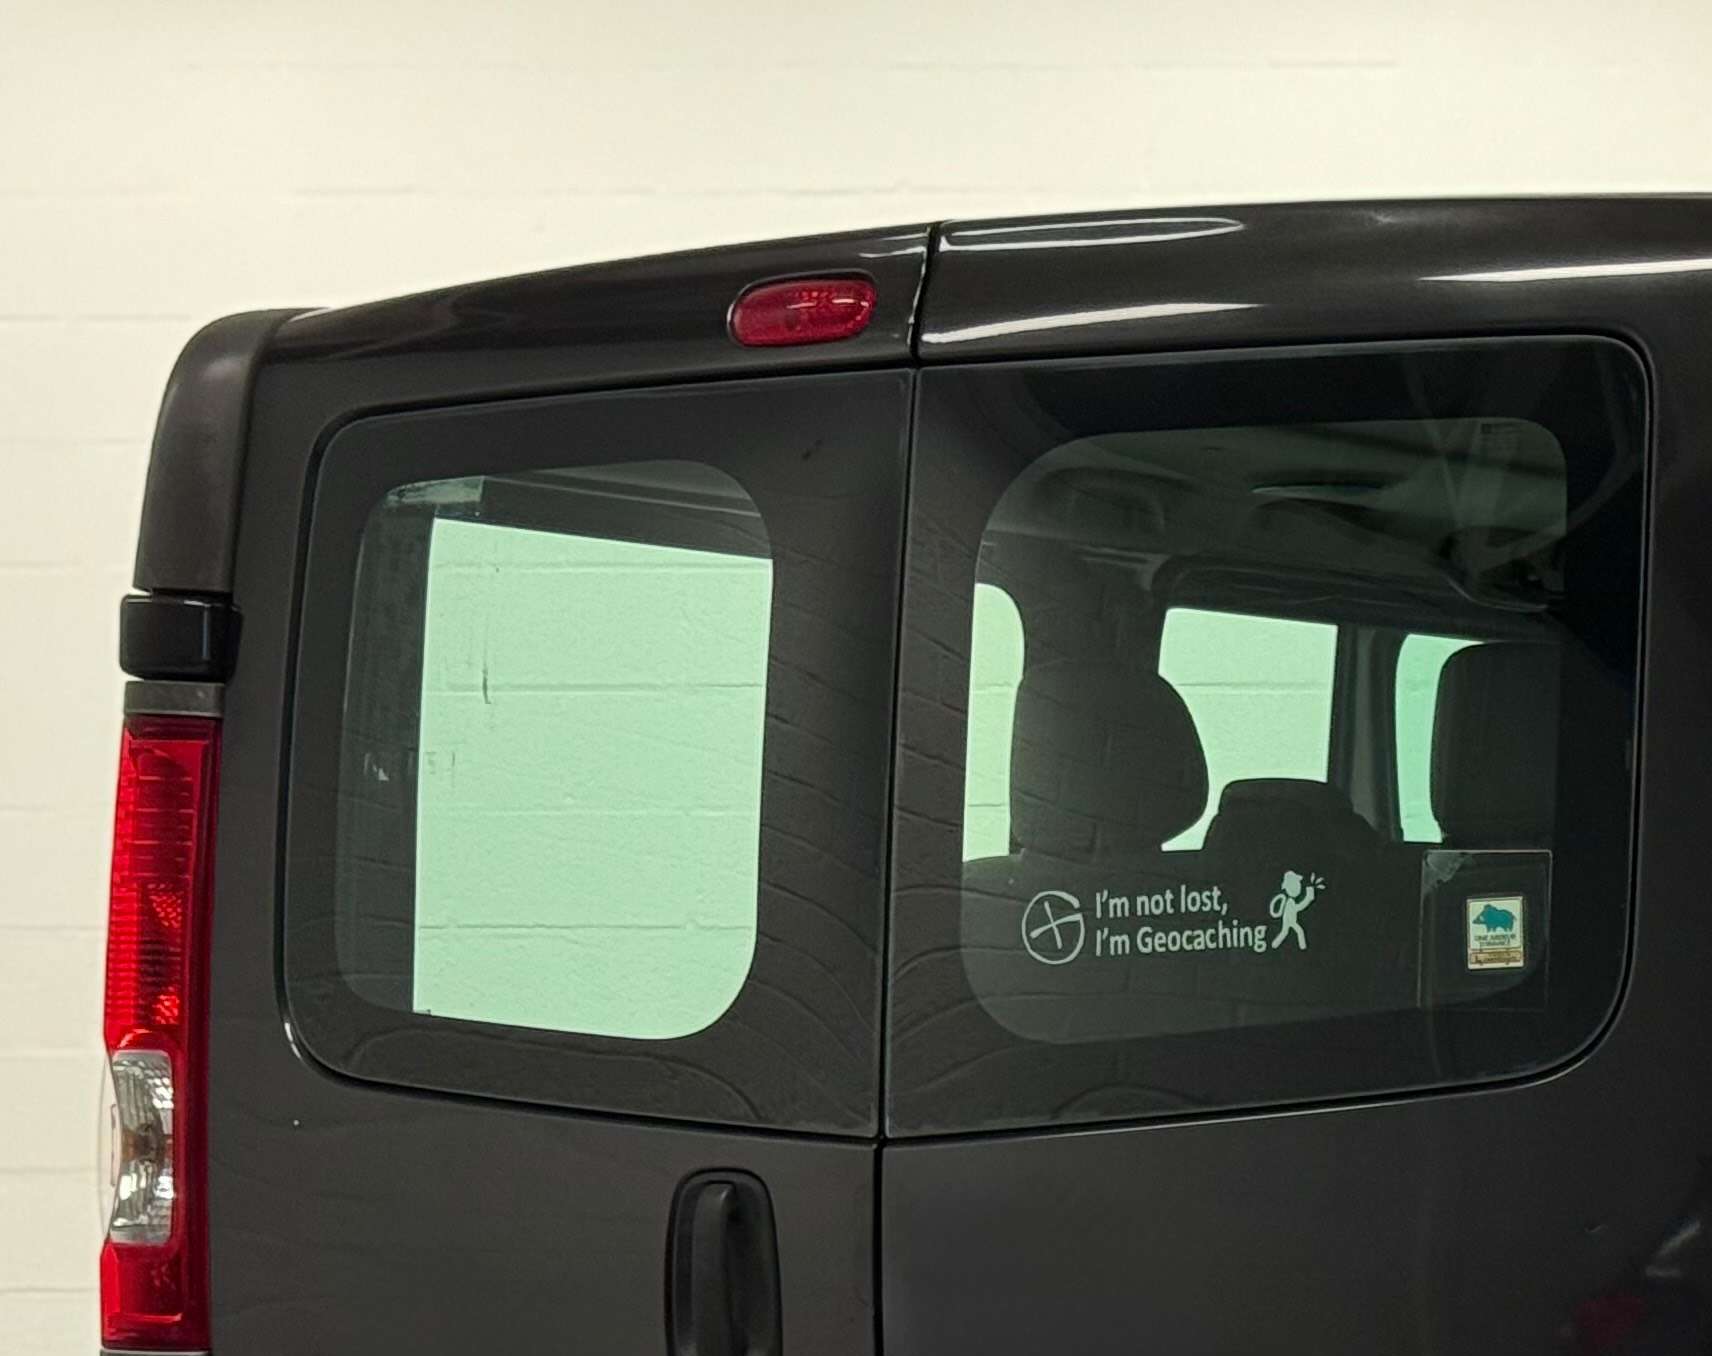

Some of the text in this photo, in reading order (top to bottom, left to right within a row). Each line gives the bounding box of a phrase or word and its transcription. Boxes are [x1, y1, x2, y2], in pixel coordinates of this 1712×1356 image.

[1095, 884, 1228, 919] I'm not lost,
[1095, 920, 1267, 956] I'm Geocaching
